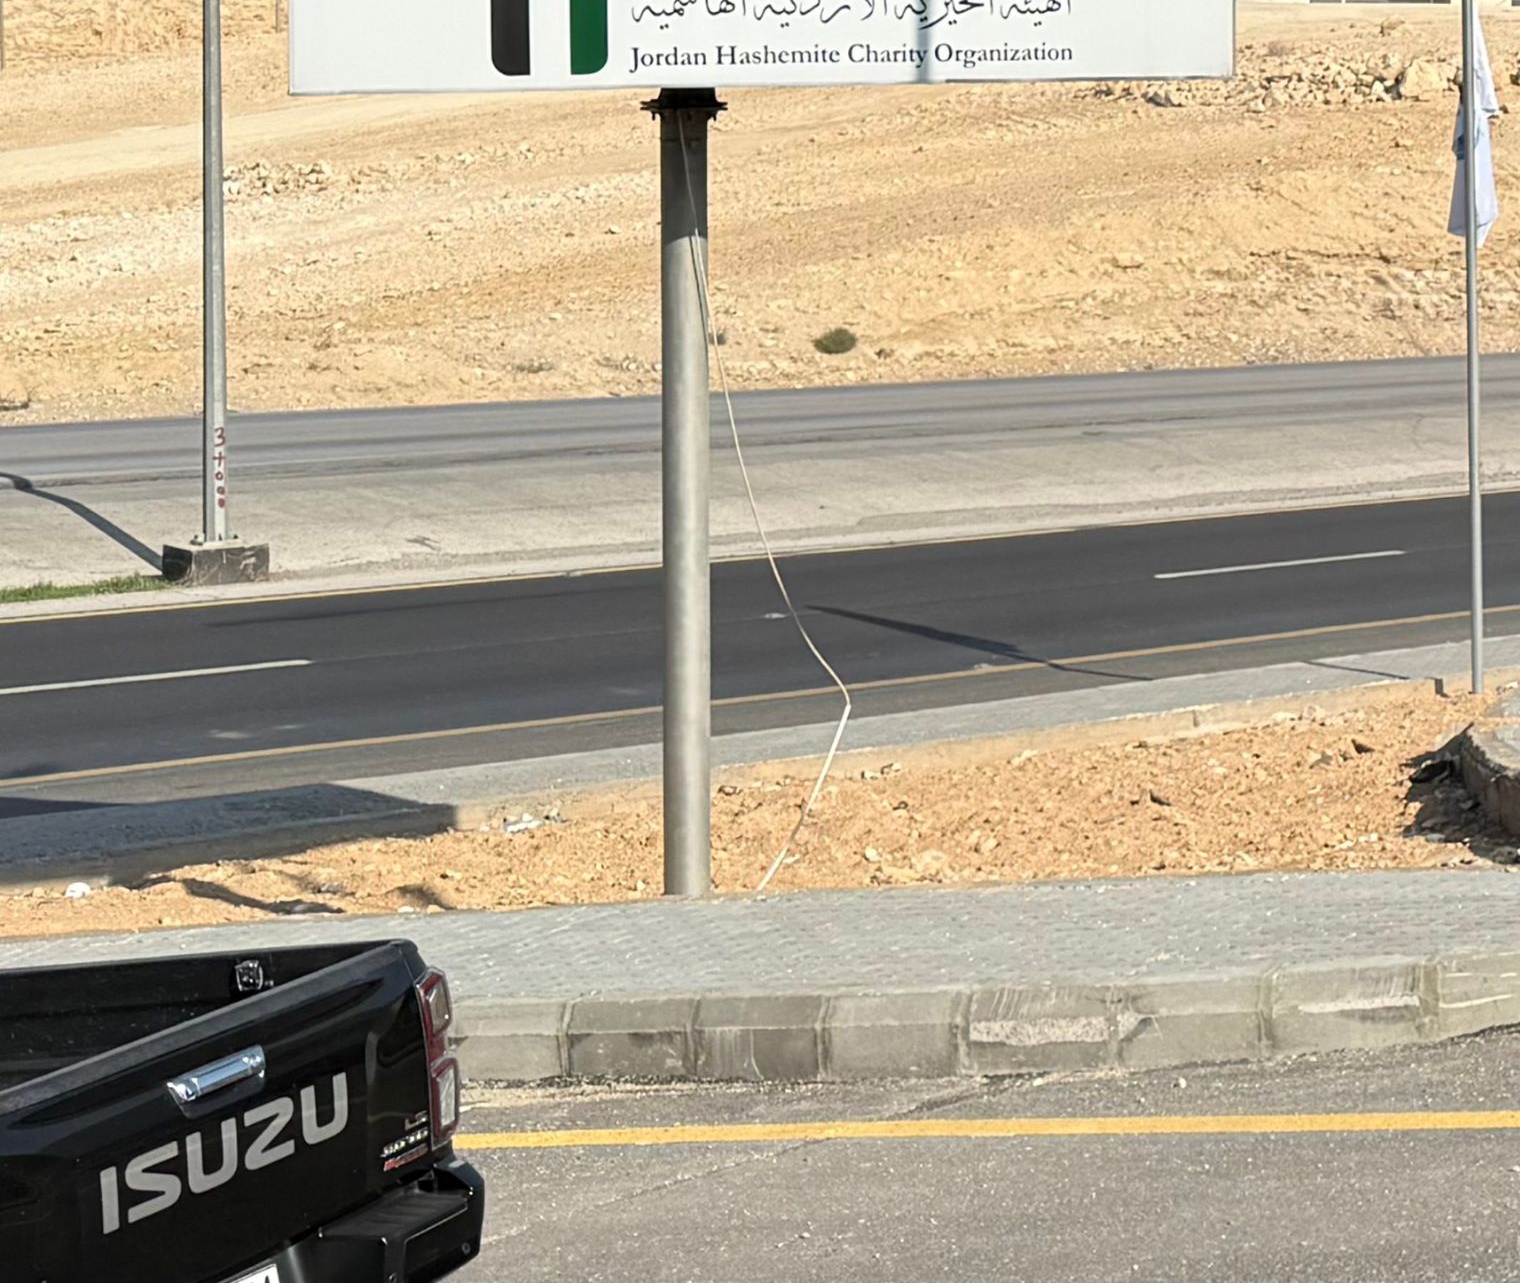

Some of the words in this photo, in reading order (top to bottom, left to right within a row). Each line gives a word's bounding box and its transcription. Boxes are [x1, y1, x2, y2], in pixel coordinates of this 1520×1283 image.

[628, 45, 708, 74] Jordan
[715, 43, 841, 66] Hashemite
[848, 43, 929, 68] Charity
[934, 42, 1073, 68] Organization
[99, 1071, 349, 1235] ISUZU
